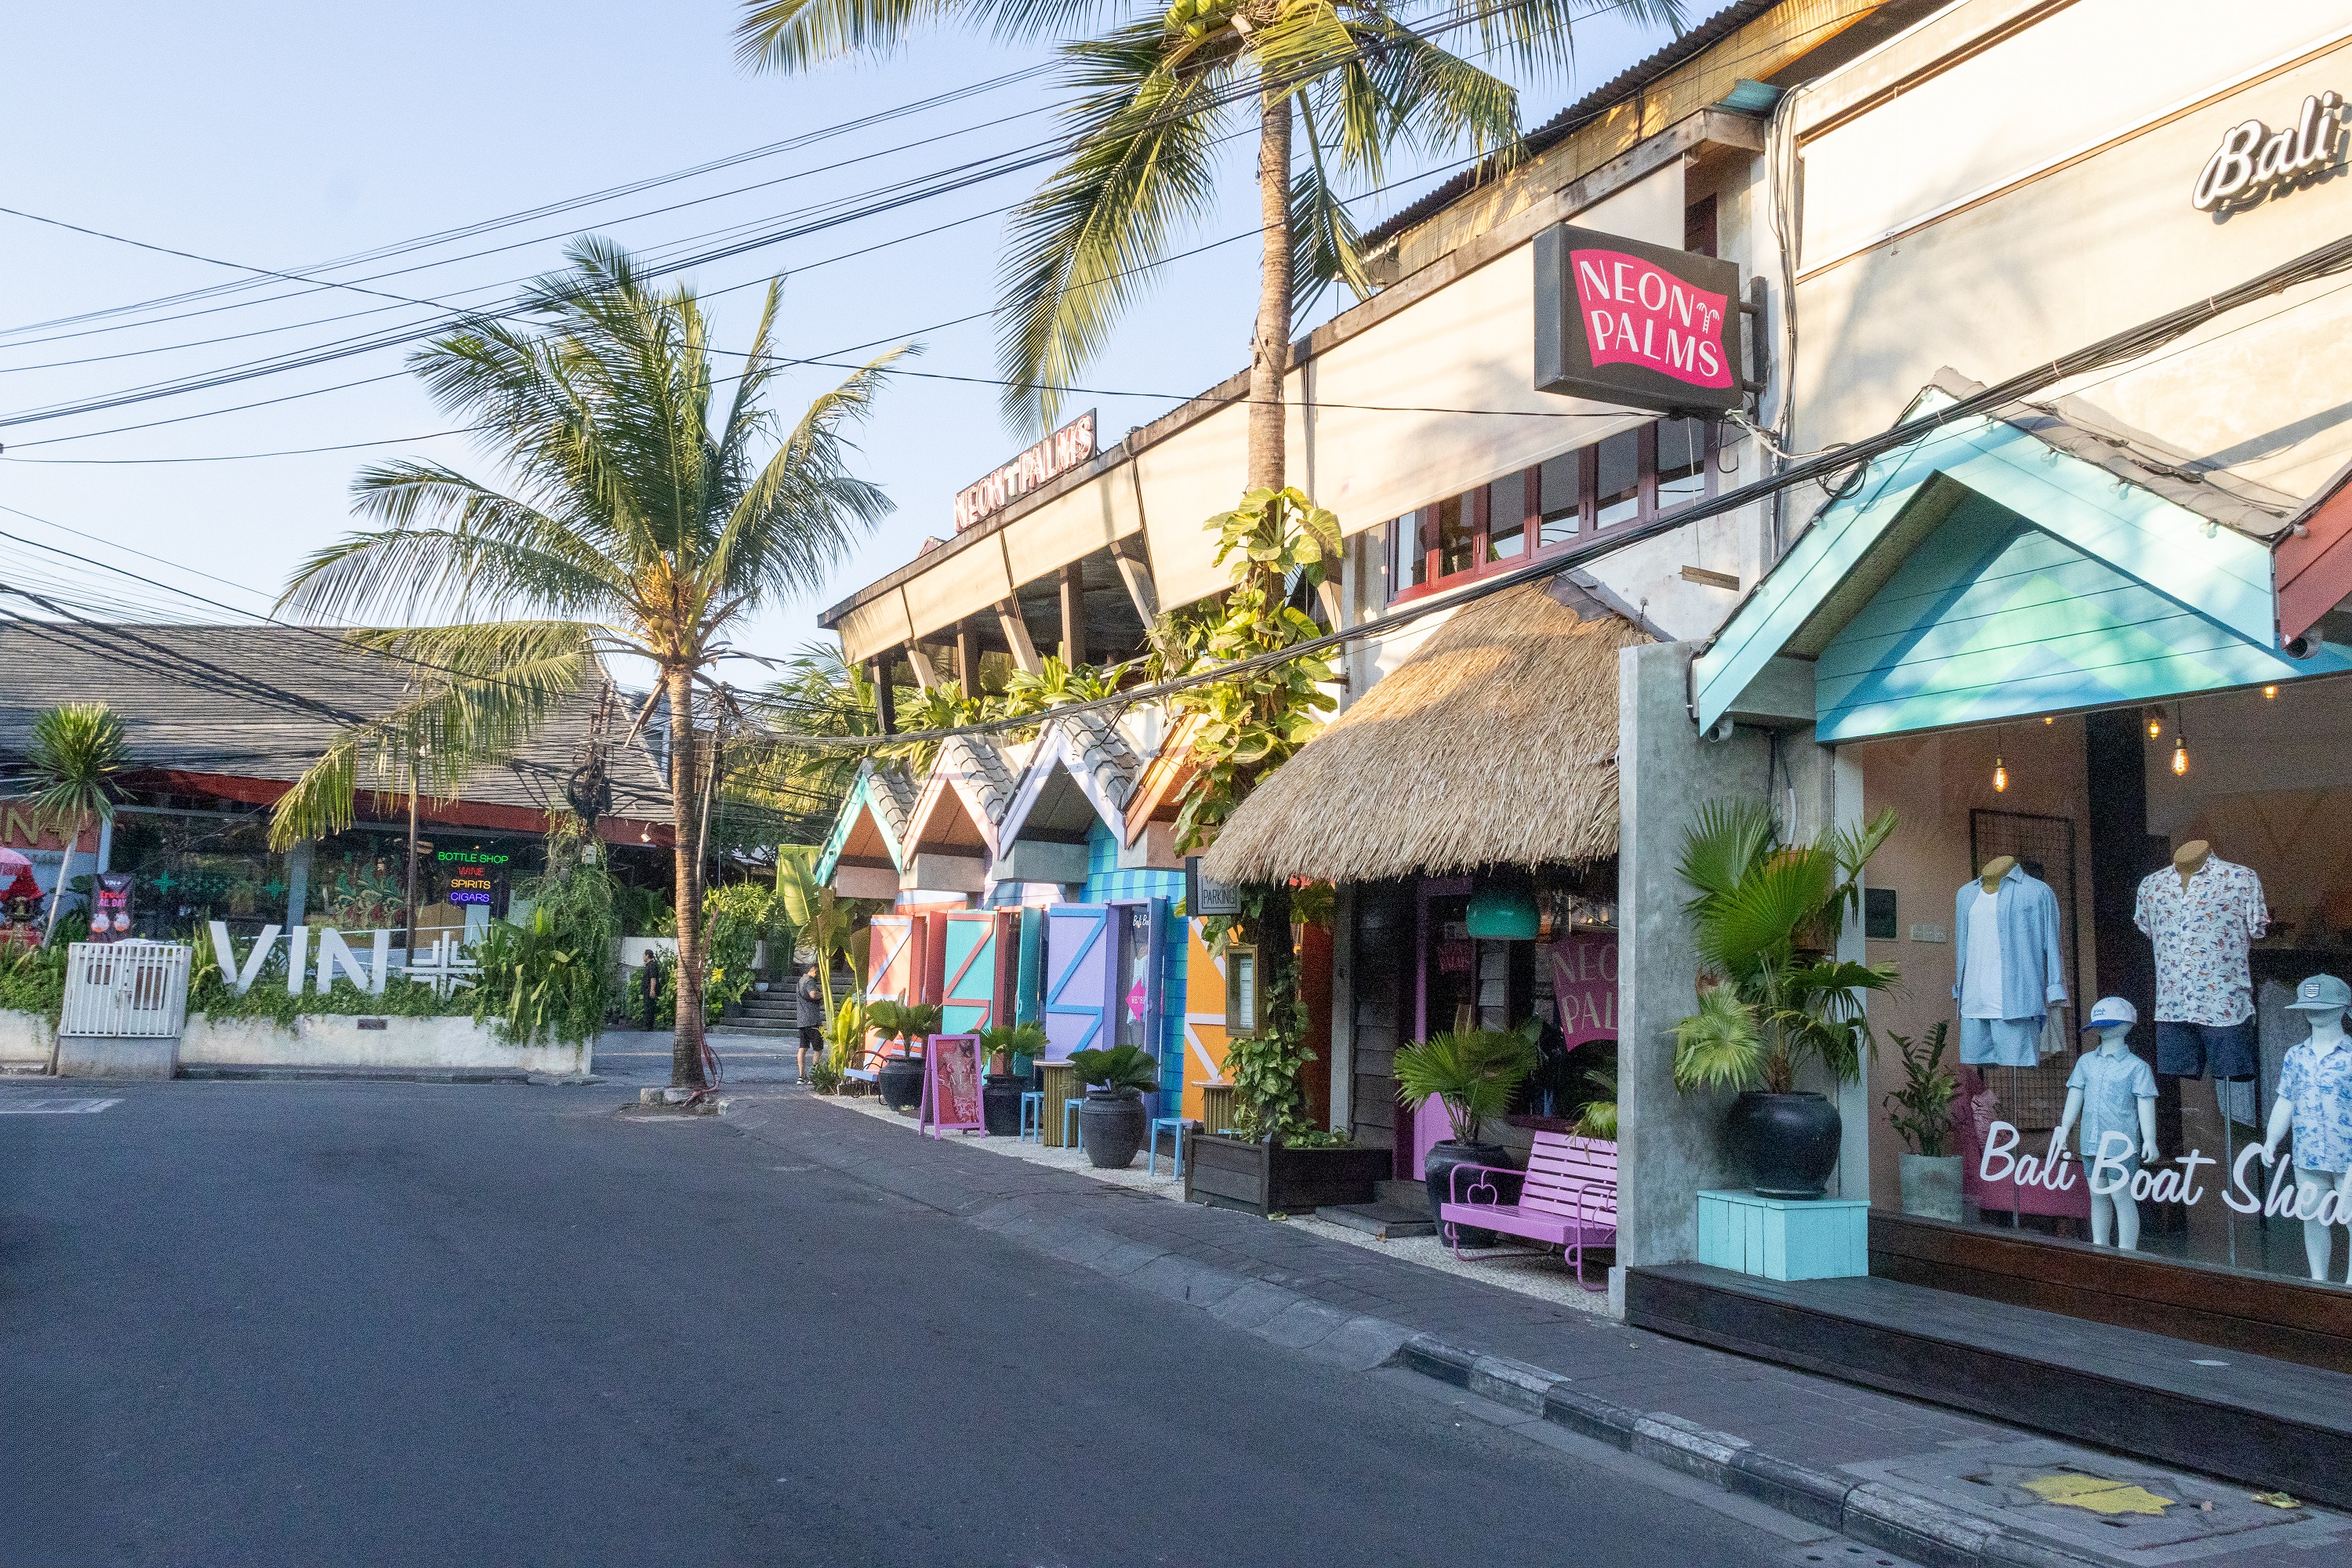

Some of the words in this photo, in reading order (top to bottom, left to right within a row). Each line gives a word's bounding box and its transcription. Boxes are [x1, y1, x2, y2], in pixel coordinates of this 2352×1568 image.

[2192, 90, 2339, 212] Bali
[1579, 260, 1694, 328] NEON
[1590, 310, 1719, 378] PALMS
[953, 467, 1006, 532] NEON
[1019, 415, 1094, 494] PALMS
[438, 851, 477, 862] BOTTLE
[479, 854, 509, 864] SHOP
[459, 866, 485, 877] WINE
[450, 892, 490, 902] CIGARS
[451, 879, 491, 889] SPIRITS
[1203, 888, 1235, 904] PARKING
[1552, 943, 1618, 988] NEO
[1562, 991, 1618, 1034] PAL
[1979, 1121, 2076, 1191] Bali
[2090, 1130, 2216, 1206] Boat
